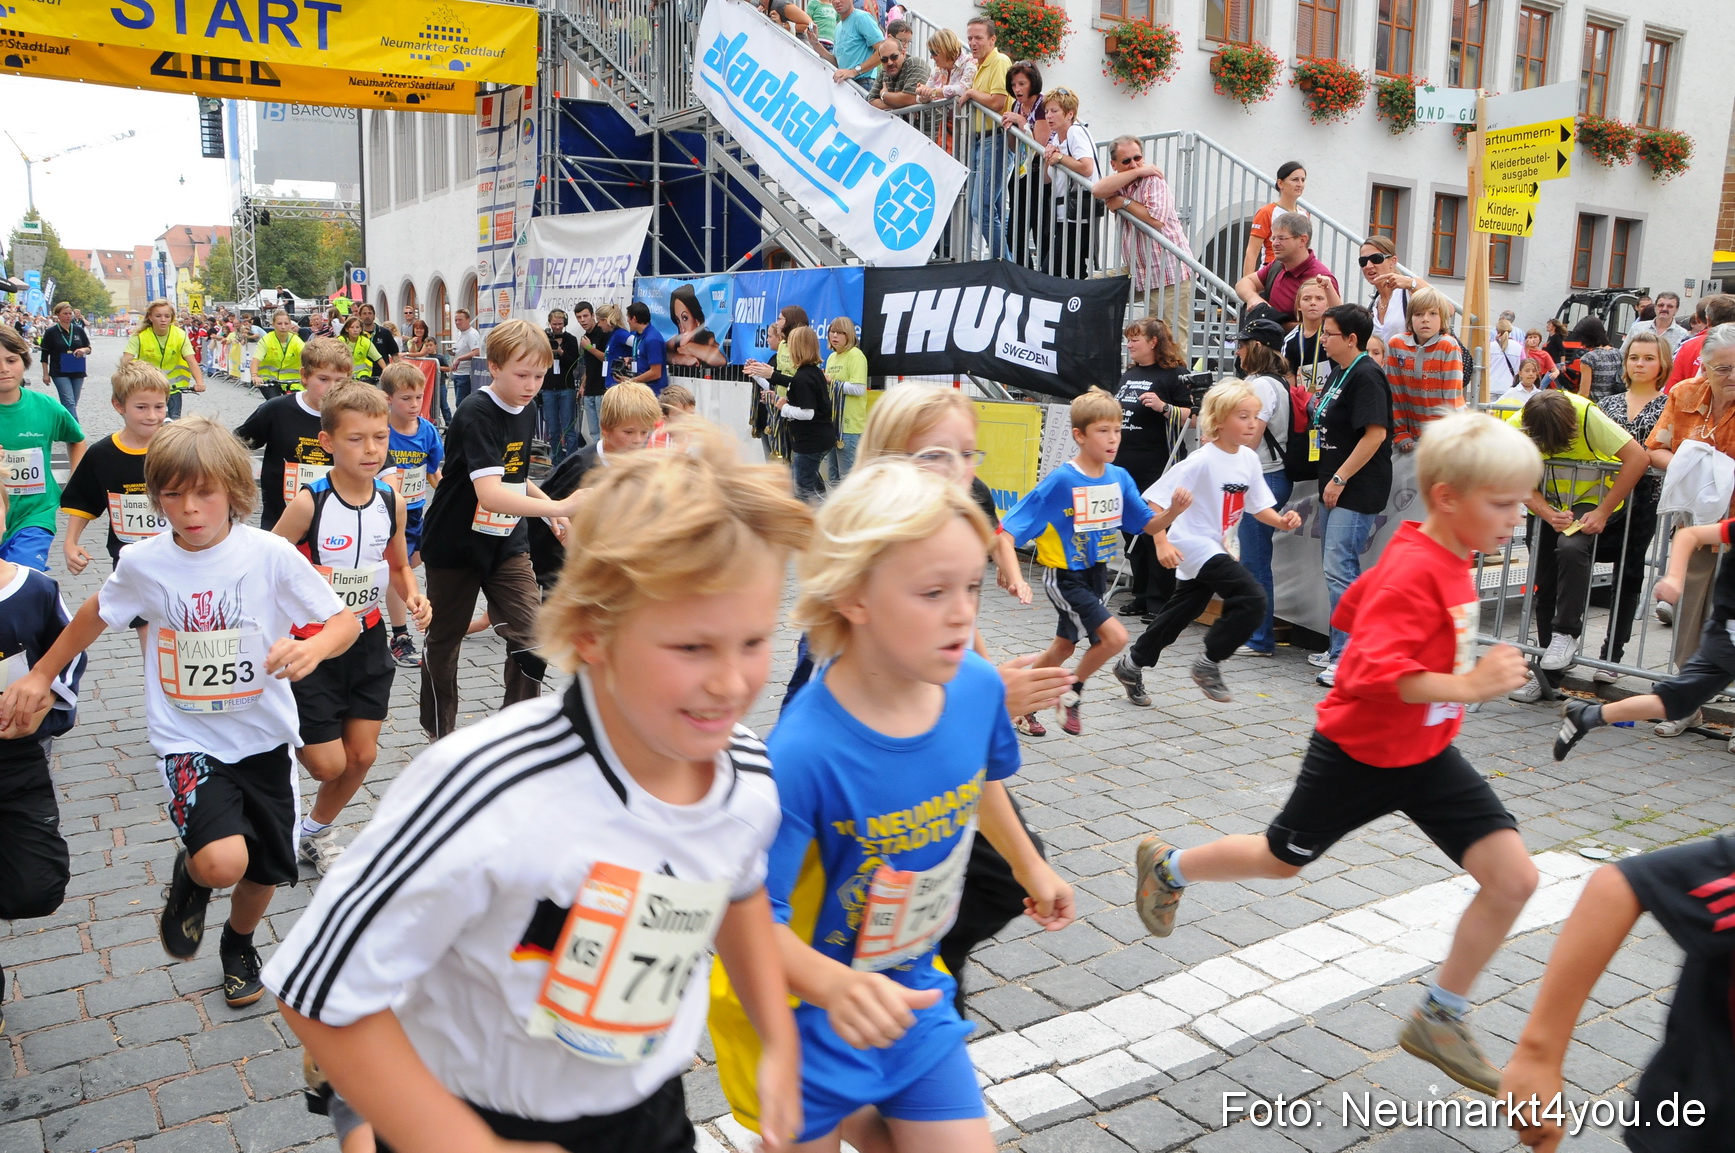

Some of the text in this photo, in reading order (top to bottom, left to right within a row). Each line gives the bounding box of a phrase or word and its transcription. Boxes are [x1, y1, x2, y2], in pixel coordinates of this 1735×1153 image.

[110, 0, 342, 50] START
[6, 38, 71, 55] Stadtlauf
[380, 36, 506, 58] Neumarkter Stadtlauf
[349, 76, 456, 91] Neumarkter Stadtlauf
[703, 31, 887, 189] slackstar
[1490, 152, 1551, 171] Kleiderbeutel-
[1501, 167, 1539, 181] ausgabe
[1486, 202, 1519, 217] Kinder-
[1479, 216, 1523, 236] betreuung
[545, 254, 632, 289] PFLEIDERER
[192, 300, 200, 310] A
[735, 290, 766, 324] maxi
[881, 286, 1063, 362] THULE
[1002, 342, 1049, 367] SWEDEN
[300, 468, 314, 478] Tim
[404, 478, 426, 493] 7197
[123, 499, 148, 509] Jonas
[1091, 498, 1121, 515] 7303
[125, 514, 167, 528] 7186
[326, 536, 345, 546] tkn
[333, 572, 368, 585] Florian
[177, 638, 250, 660] MANUEL
[184, 660, 255, 687] 7253
